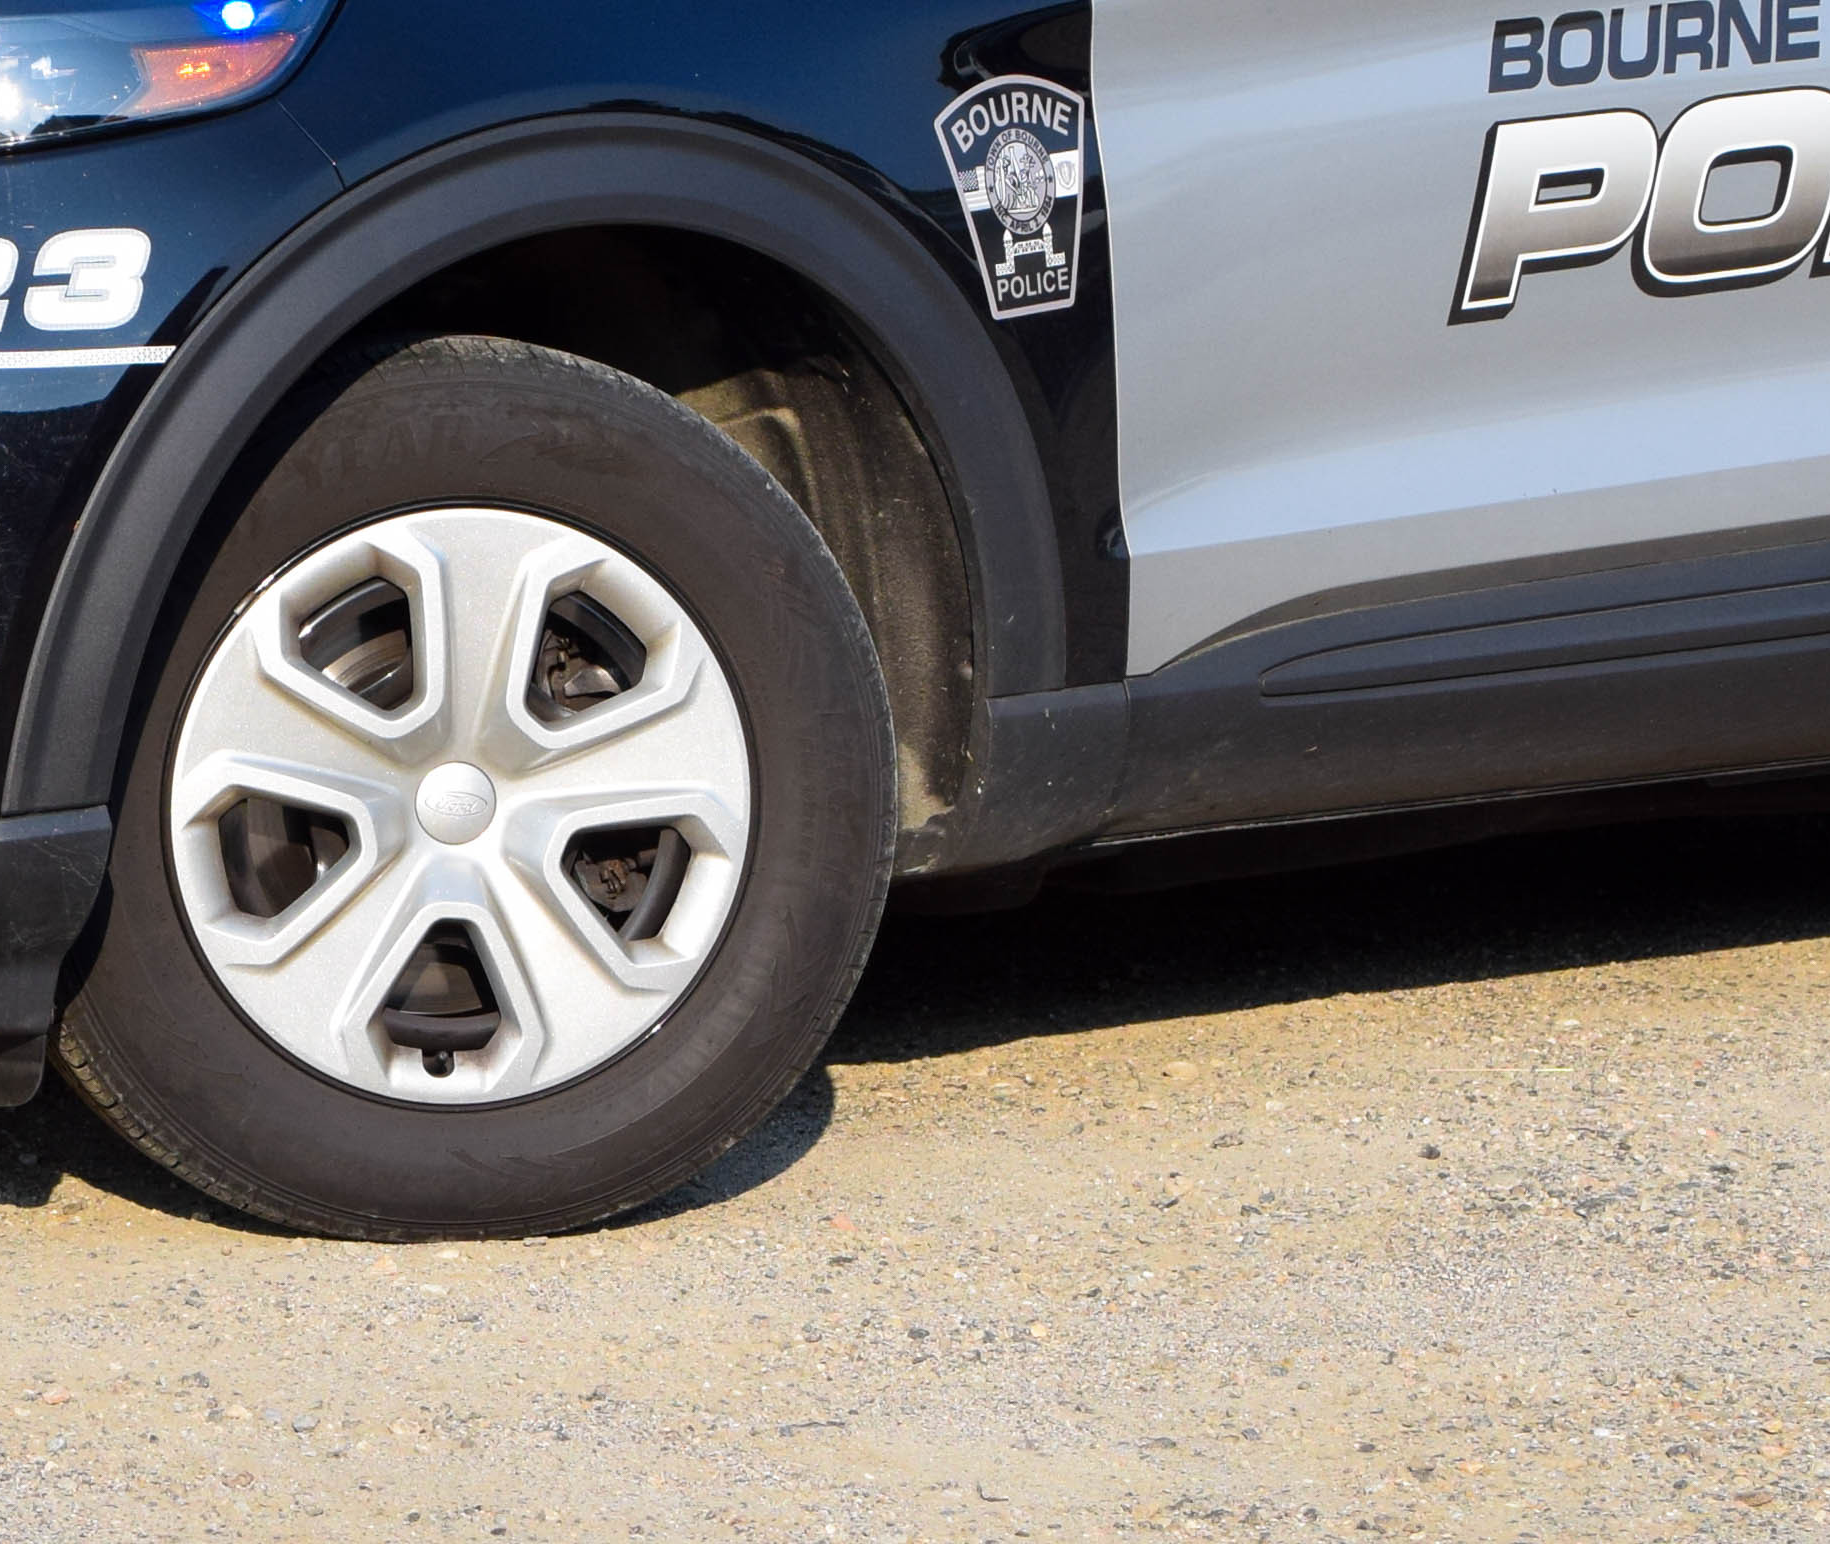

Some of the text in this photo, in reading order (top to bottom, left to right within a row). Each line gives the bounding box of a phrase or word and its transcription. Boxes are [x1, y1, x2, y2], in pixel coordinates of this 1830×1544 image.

[951, 91, 1072, 154] BOURNE
[986, 130, 1050, 172] TOWN OF BOURNE
[1009, 218, 1035, 233] APRIL
[997, 267, 1070, 302] POLICE
